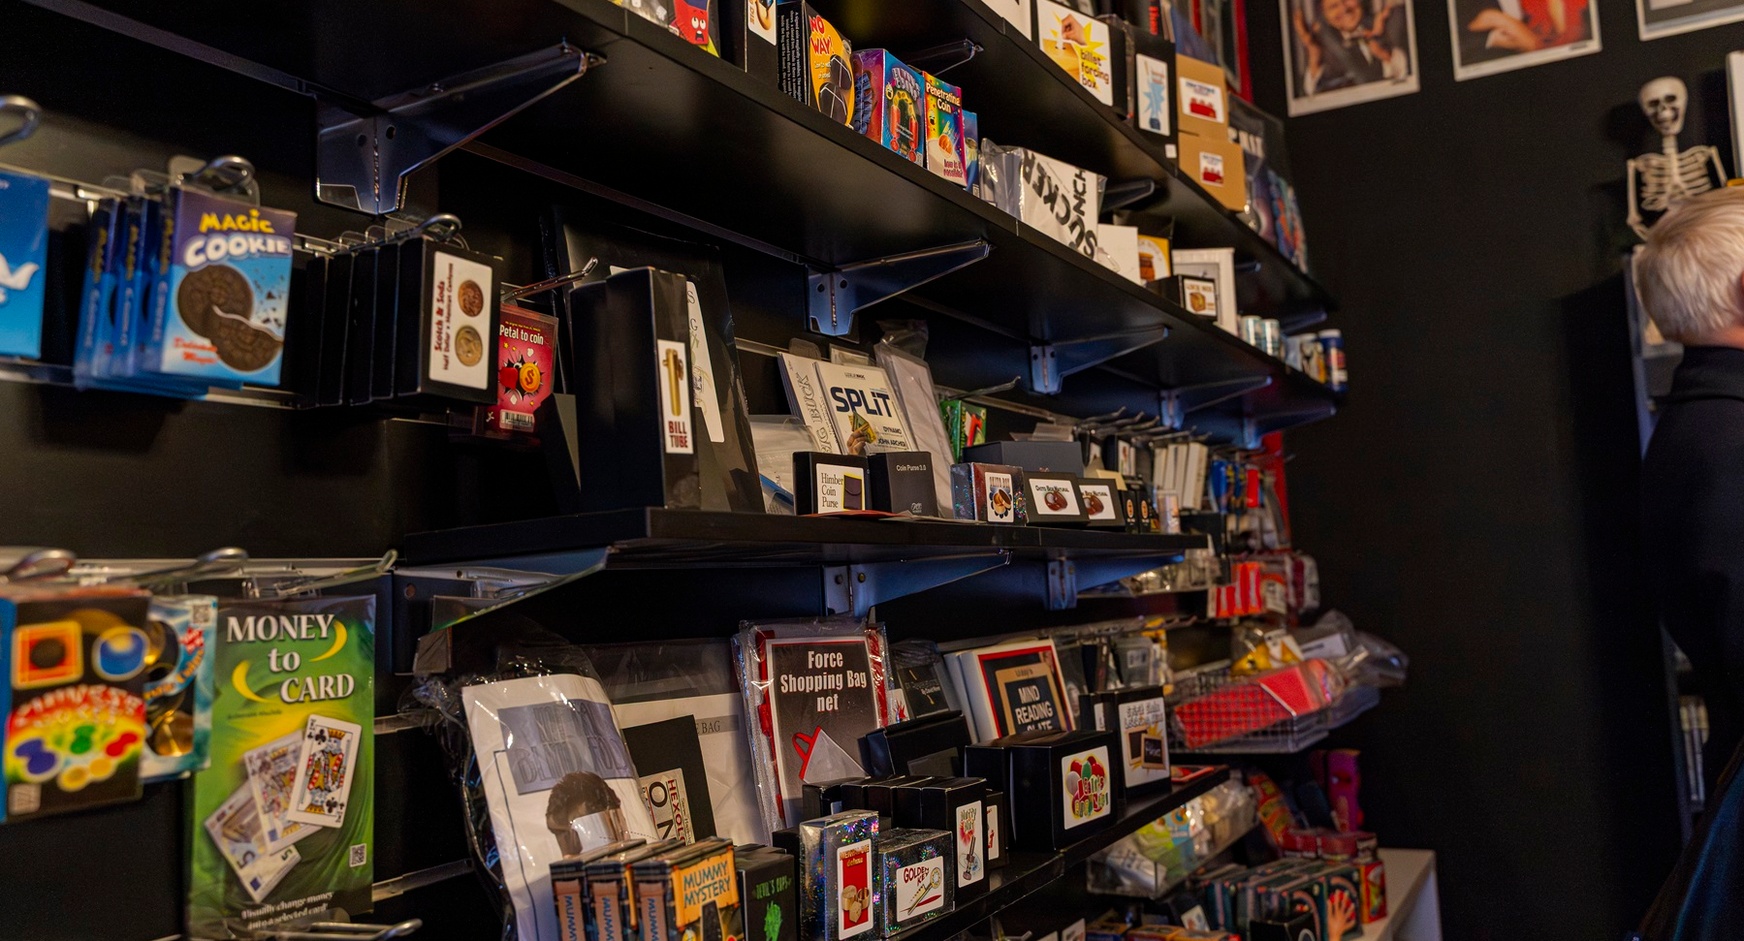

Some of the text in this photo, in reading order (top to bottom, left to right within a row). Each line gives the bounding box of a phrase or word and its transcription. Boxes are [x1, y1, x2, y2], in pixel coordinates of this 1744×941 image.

[809, 15, 825, 34] NO
[1080, 50, 1102, 66] billet
[1081, 62, 1110, 86] forcing
[1082, 74, 1098, 88] box
[926, 82, 961, 106] Penetrating
[937, 98, 952, 114] Coin
[184, 234, 291, 268] COOKIE
[436, 281, 445, 304] Soda
[434, 320, 443, 352] Scotch
[500, 324, 519, 340] Petal
[520, 329, 529, 342] to
[529, 333, 544, 346] coin
[668, 420, 687, 435] BILL
[669, 435, 689, 449] TUBE
[820, 472, 844, 485] Himber
[822, 485, 837, 497] Coin
[822, 496, 838, 509] Purse
[226, 614, 334, 642] MONEY
[268, 648, 300, 672] to
[808, 651, 844, 669] Force
[280, 674, 354, 703] CARD
[780, 670, 867, 693] Shopping Bag
[817, 694, 839, 712] net
[1018, 685, 1040, 704] MIND
[1015, 701, 1053, 725] READING
[701, 720, 720, 734] BAG
[683, 861, 728, 891] MUMMY
[903, 865, 930, 884] GOLDEN
[917, 872, 930, 885] KEY
[684, 875, 731, 908] MYSTERY
